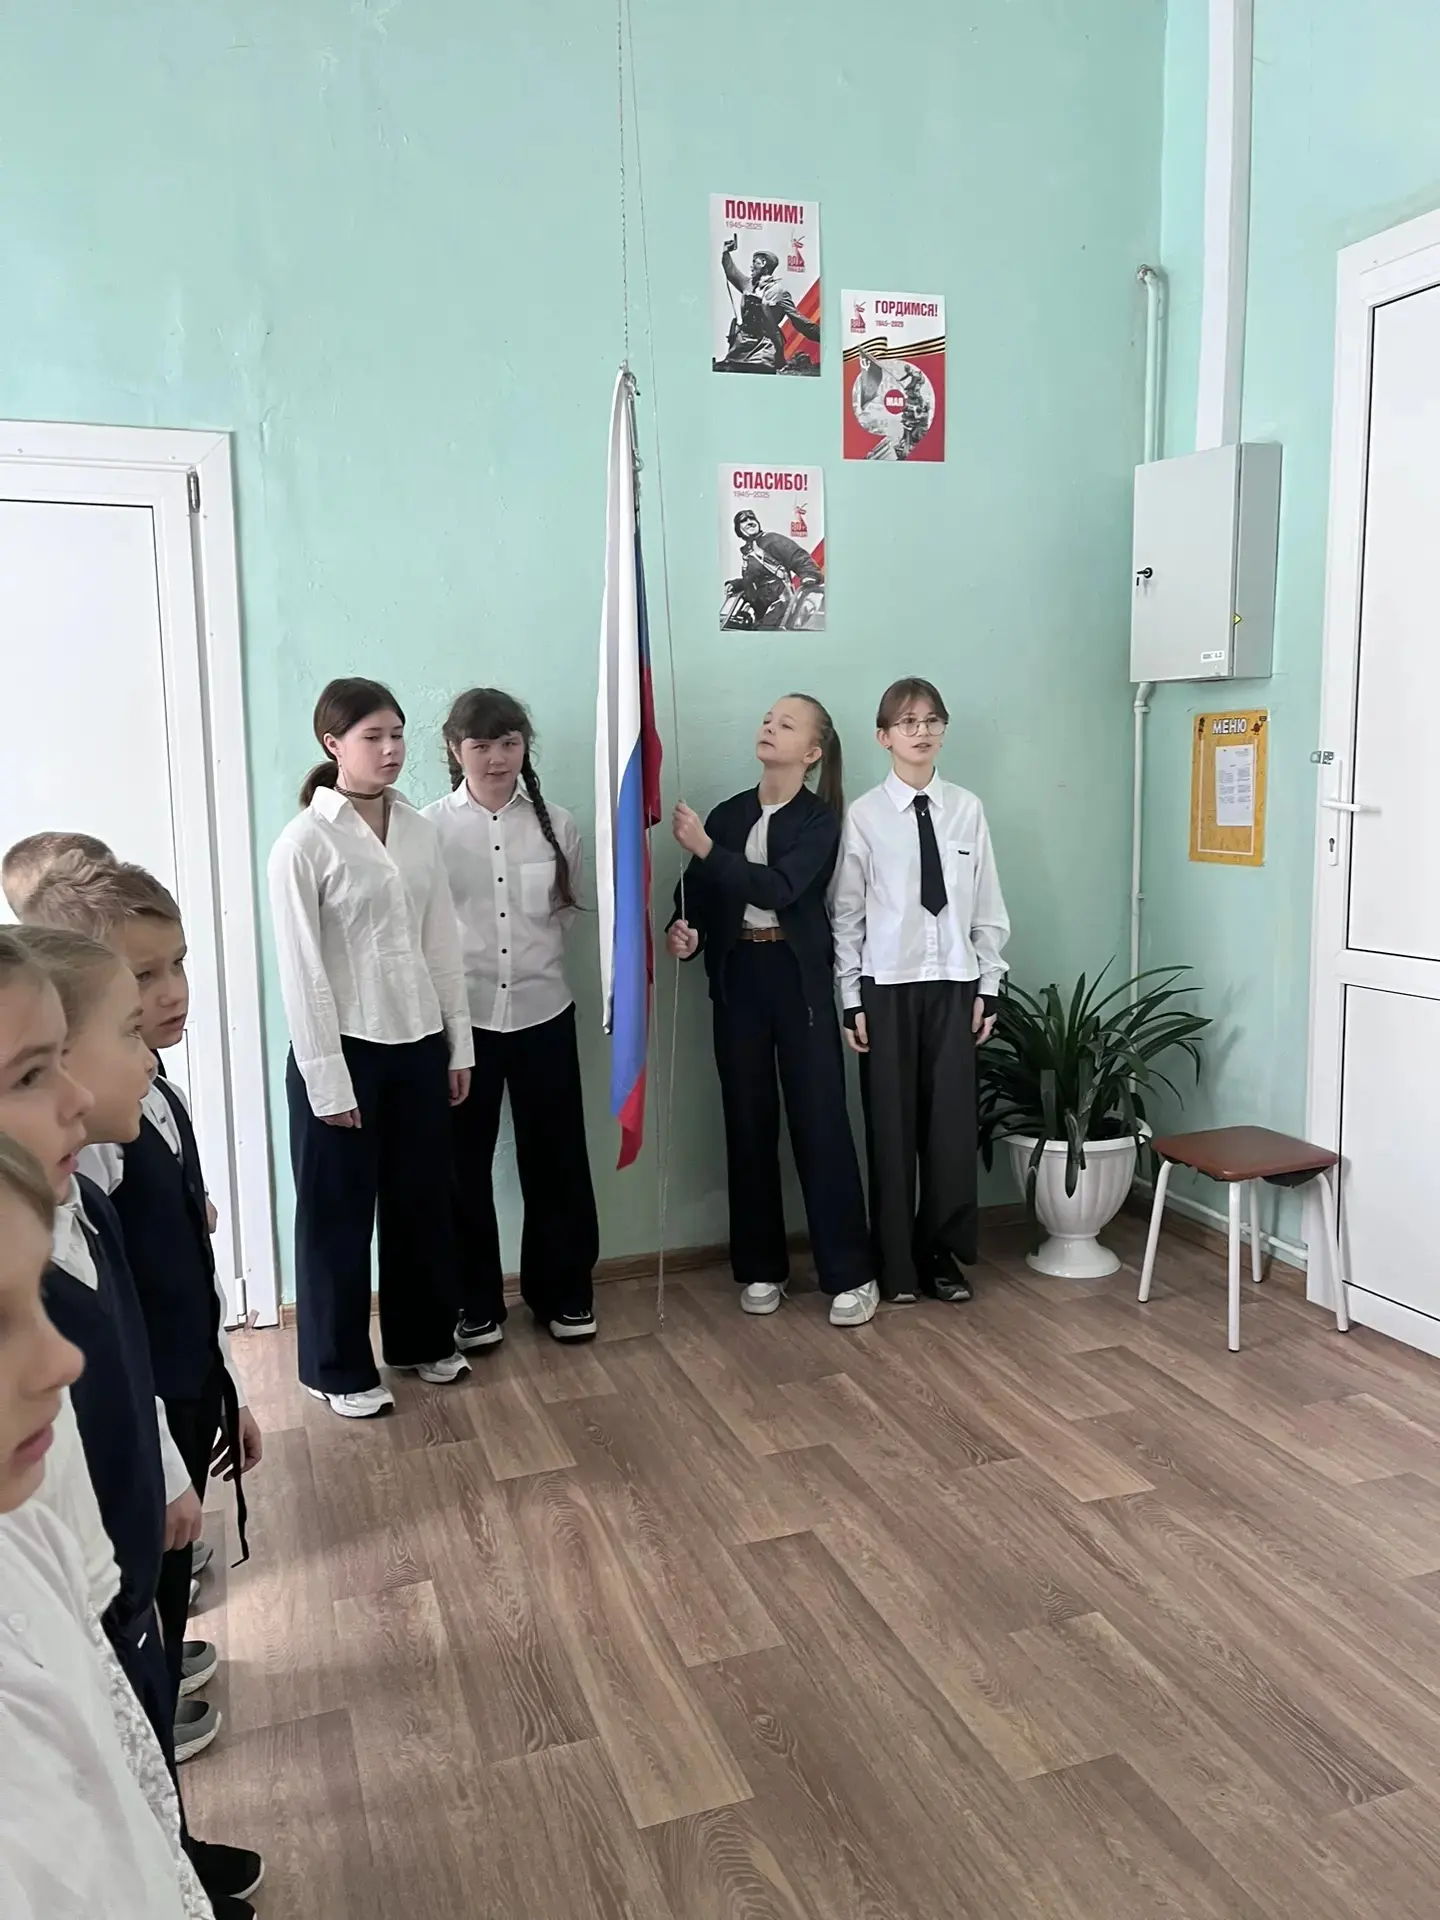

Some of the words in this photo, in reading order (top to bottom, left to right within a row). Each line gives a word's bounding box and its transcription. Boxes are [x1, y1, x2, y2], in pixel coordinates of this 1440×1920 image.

[725, 199, 803, 224] ПОМНИМ!
[875, 300, 938, 317] ГОРДИМСЯ!
[886, 397, 904, 407] МАЯ
[733, 471, 808, 491] СПАСИБО!
[1212, 718, 1247, 735] МЕНЮ
